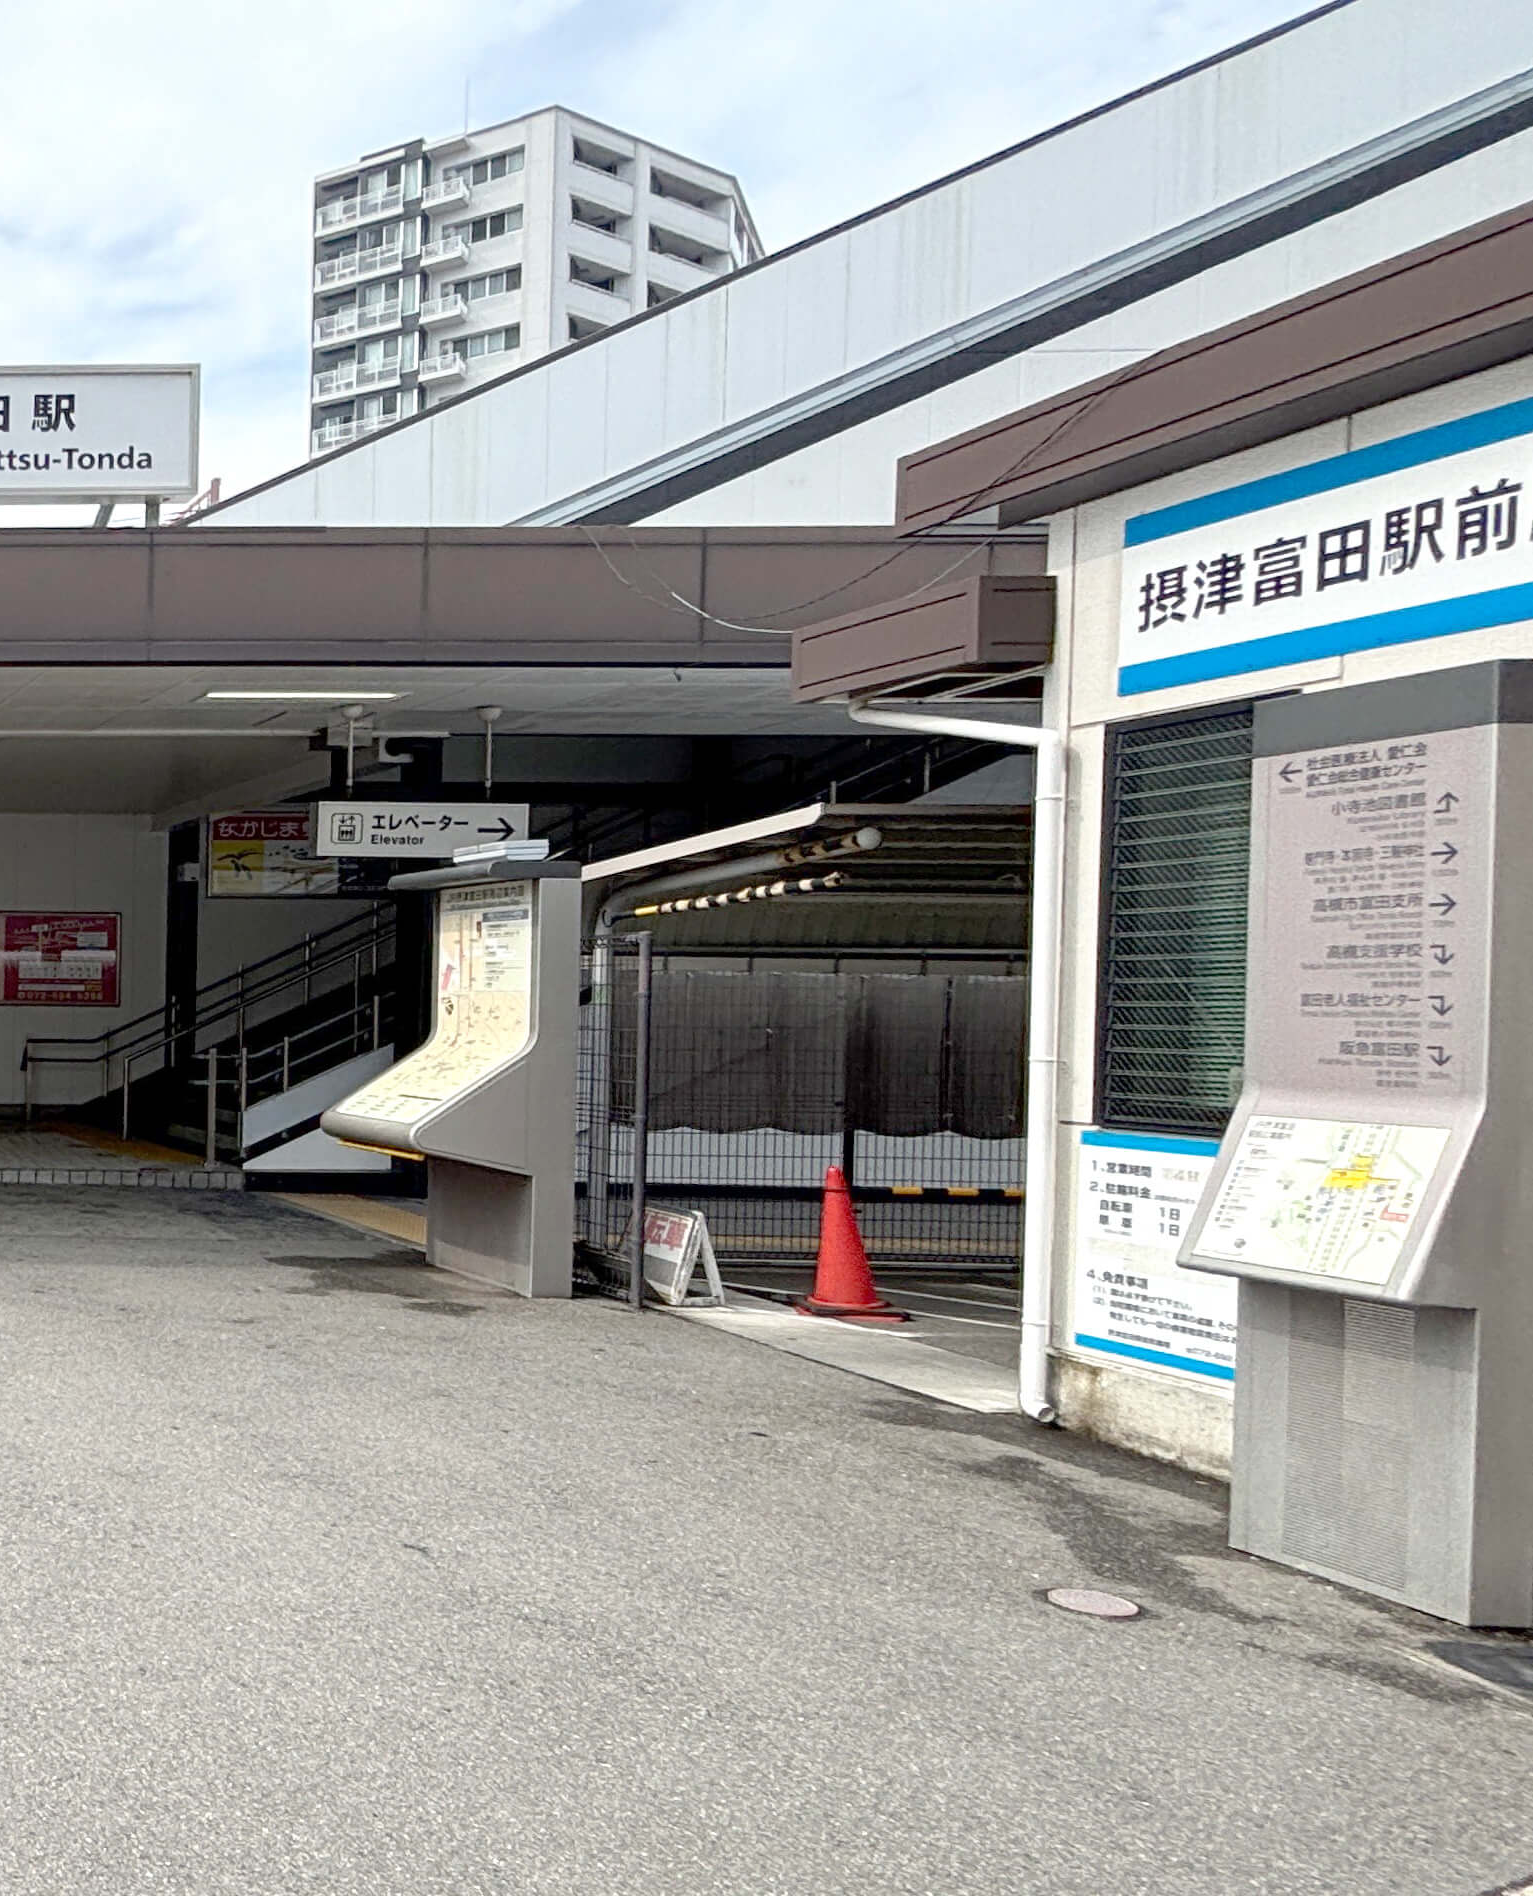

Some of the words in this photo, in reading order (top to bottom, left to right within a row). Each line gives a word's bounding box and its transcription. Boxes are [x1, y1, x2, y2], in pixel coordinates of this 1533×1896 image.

[1138, 478, 1533, 632] 摂津富田駅前
[1332, 792, 1427, 816] 小寺池図書館
[217, 820, 309, 838] なかじま
[370, 813, 469, 832] エレベーター
[370, 833, 425, 846] Elevator
[1339, 1040, 1421, 1058] 阪急富田駅
[1099, 1199, 1133, 1214] 自転車
[1159, 1206, 1181, 1222] 1日
[1159, 1222, 1181, 1237] 1日
